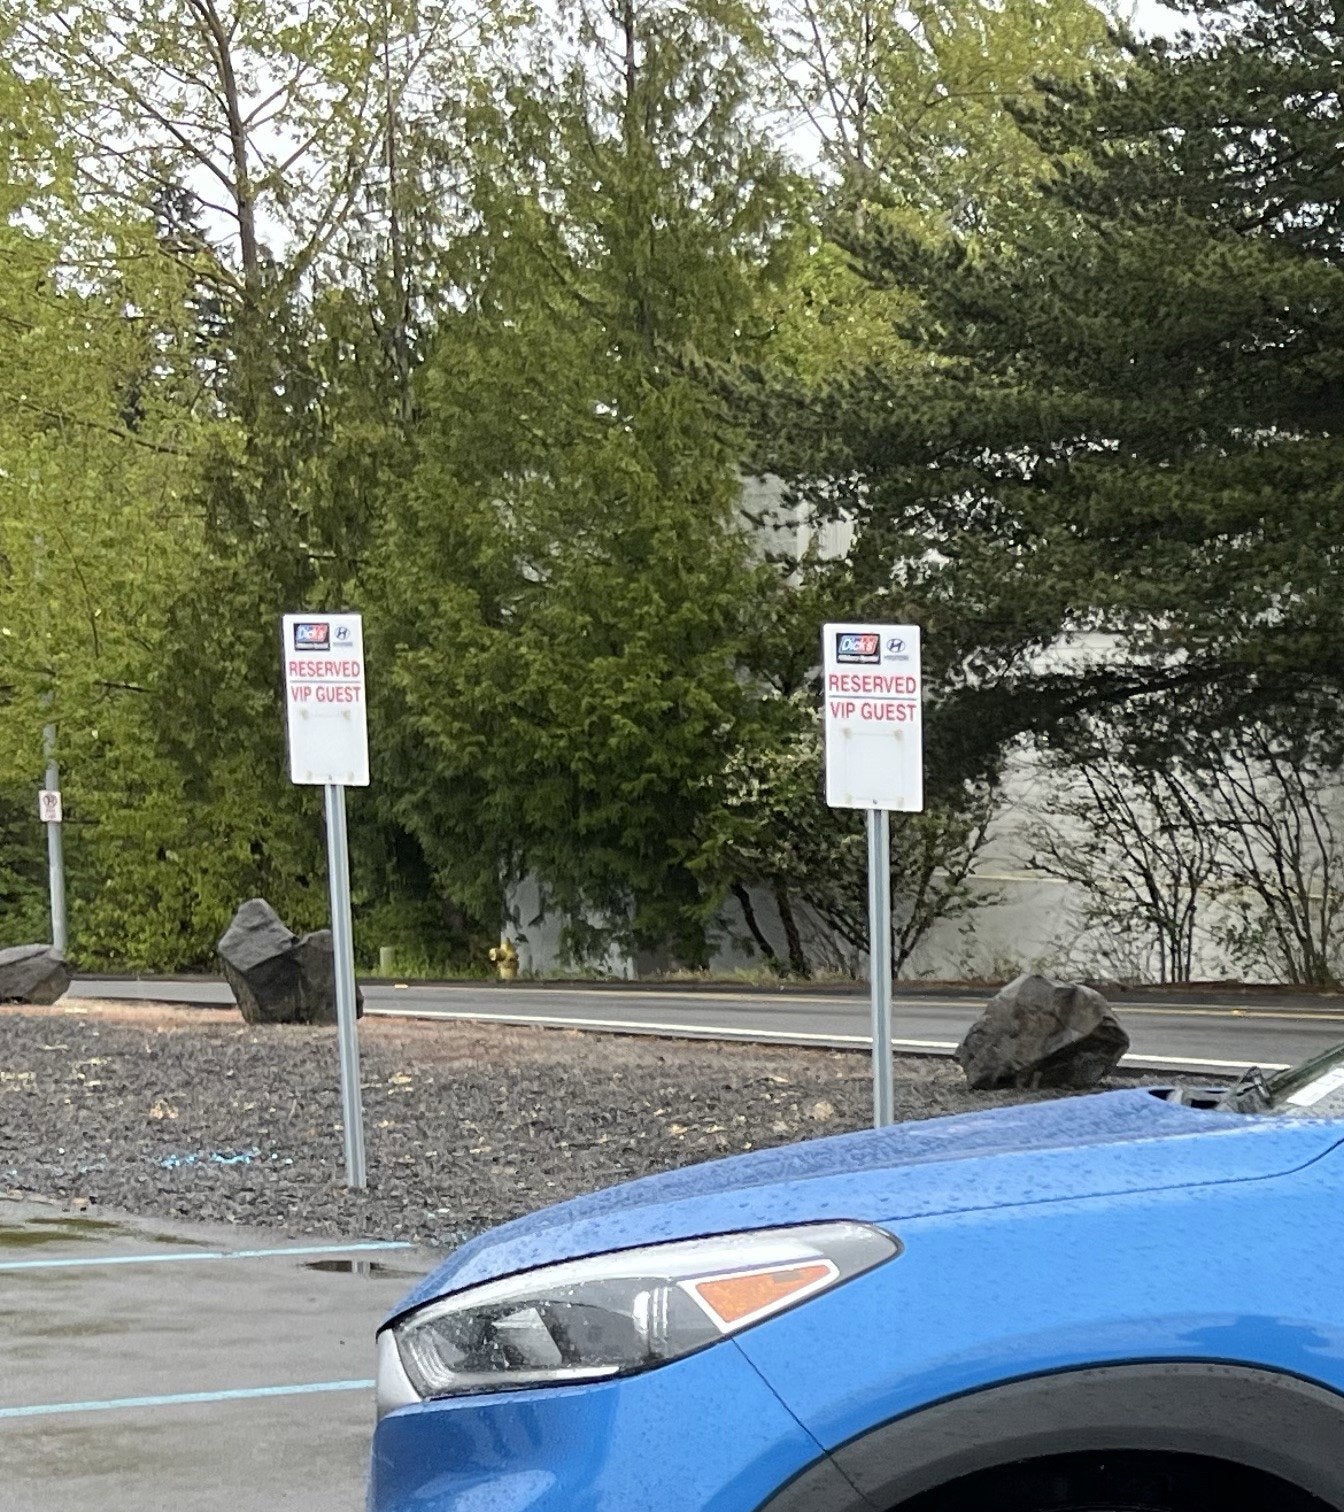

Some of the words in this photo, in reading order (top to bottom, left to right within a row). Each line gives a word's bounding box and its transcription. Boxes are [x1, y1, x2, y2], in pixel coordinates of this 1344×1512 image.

[288, 660, 361, 678] RESERVED
[828, 674, 917, 694] RESERVED
[291, 686, 312, 702] VIP
[316, 686, 361, 703] GUEST
[830, 702, 856, 719] VIP
[861, 703, 917, 721] GUEST
